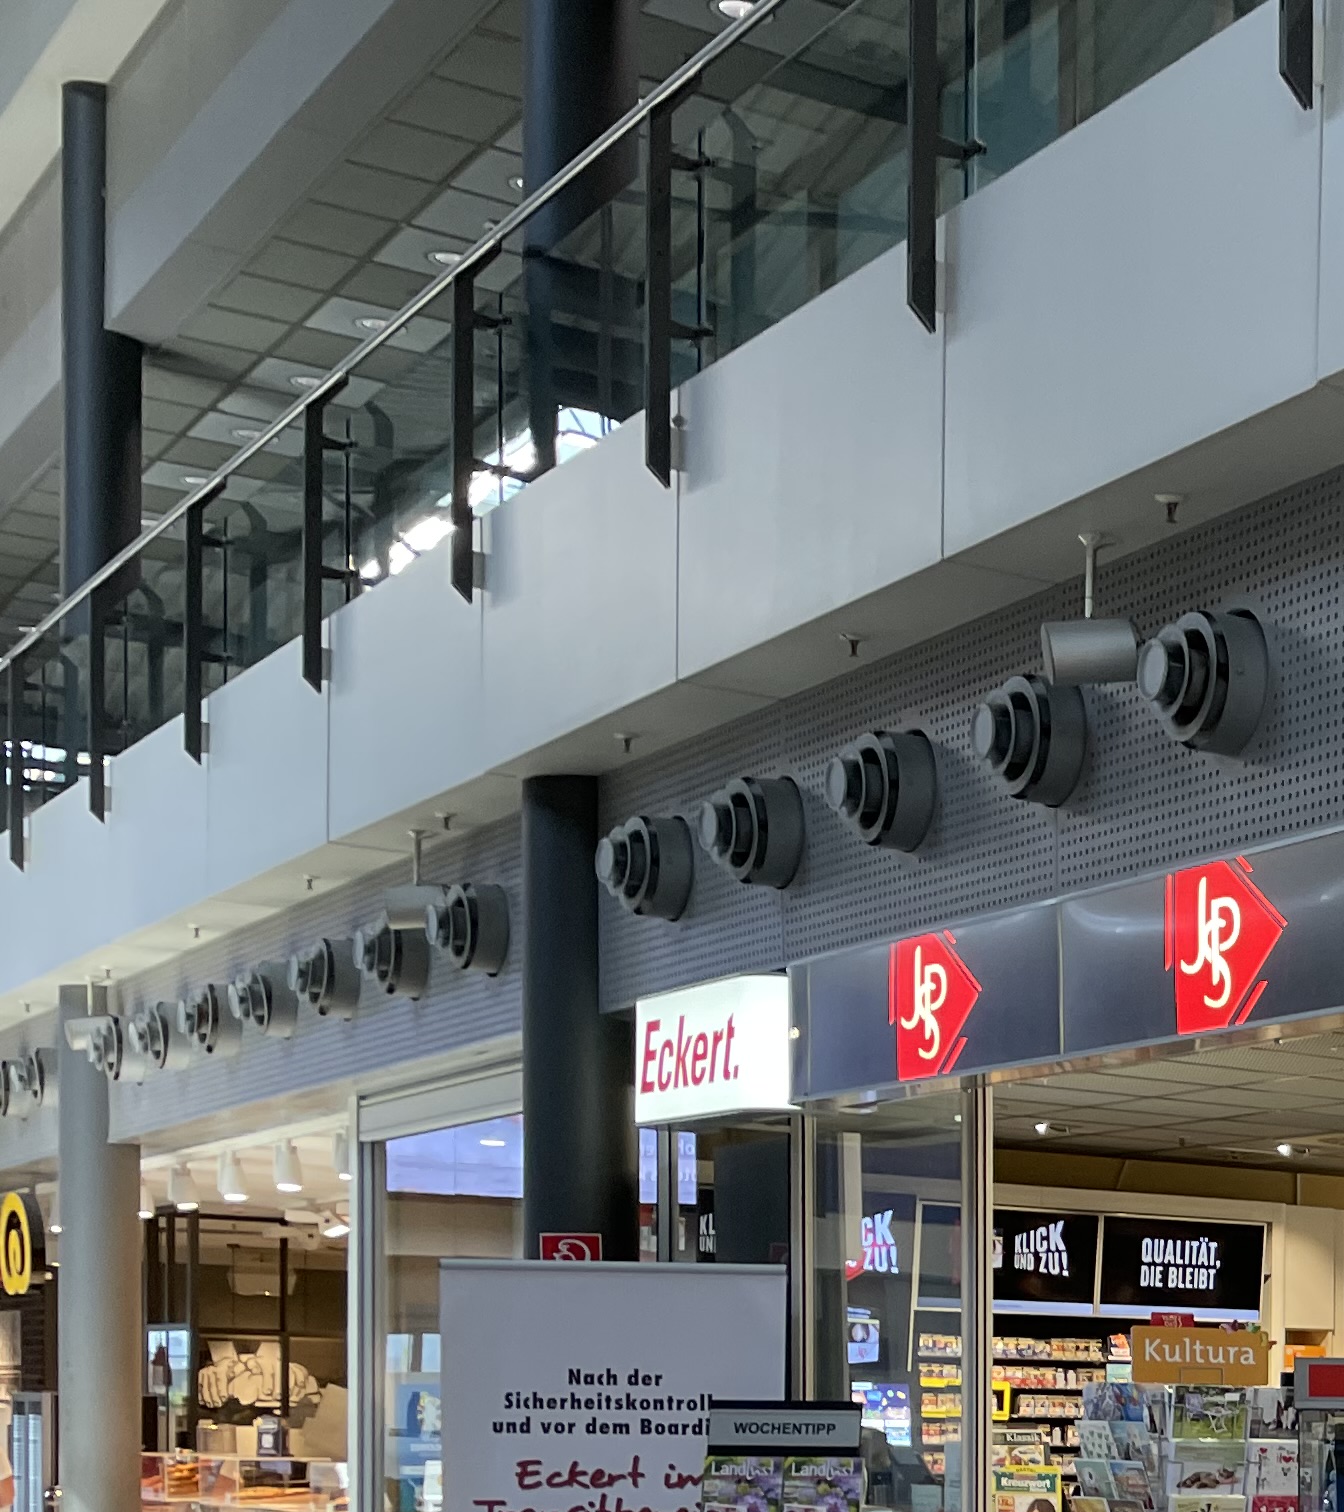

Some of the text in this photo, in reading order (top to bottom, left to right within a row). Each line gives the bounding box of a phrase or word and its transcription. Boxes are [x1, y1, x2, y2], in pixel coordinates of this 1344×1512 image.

[640, 1013, 739, 1094] Eckert.
[1014, 1220, 1066, 1254] KLICK
[863, 1245, 899, 1275] ZU!
[1013, 1251, 1070, 1277] UND ZU!
[1141, 1237, 1221, 1269] QUALITÄT,
[1140, 1265, 1217, 1290] DIE BLEIBT
[1144, 1337, 1256, 1365] Kultura
[568, 1368, 663, 1387] Nach der
[504, 1392, 713, 1412] Sicherheitskontroll
[492, 1416, 710, 1436] und vor dem Boardi
[733, 1422, 836, 1436] WOCHENTIPP
[516, 1455, 645, 1490] Eckert
